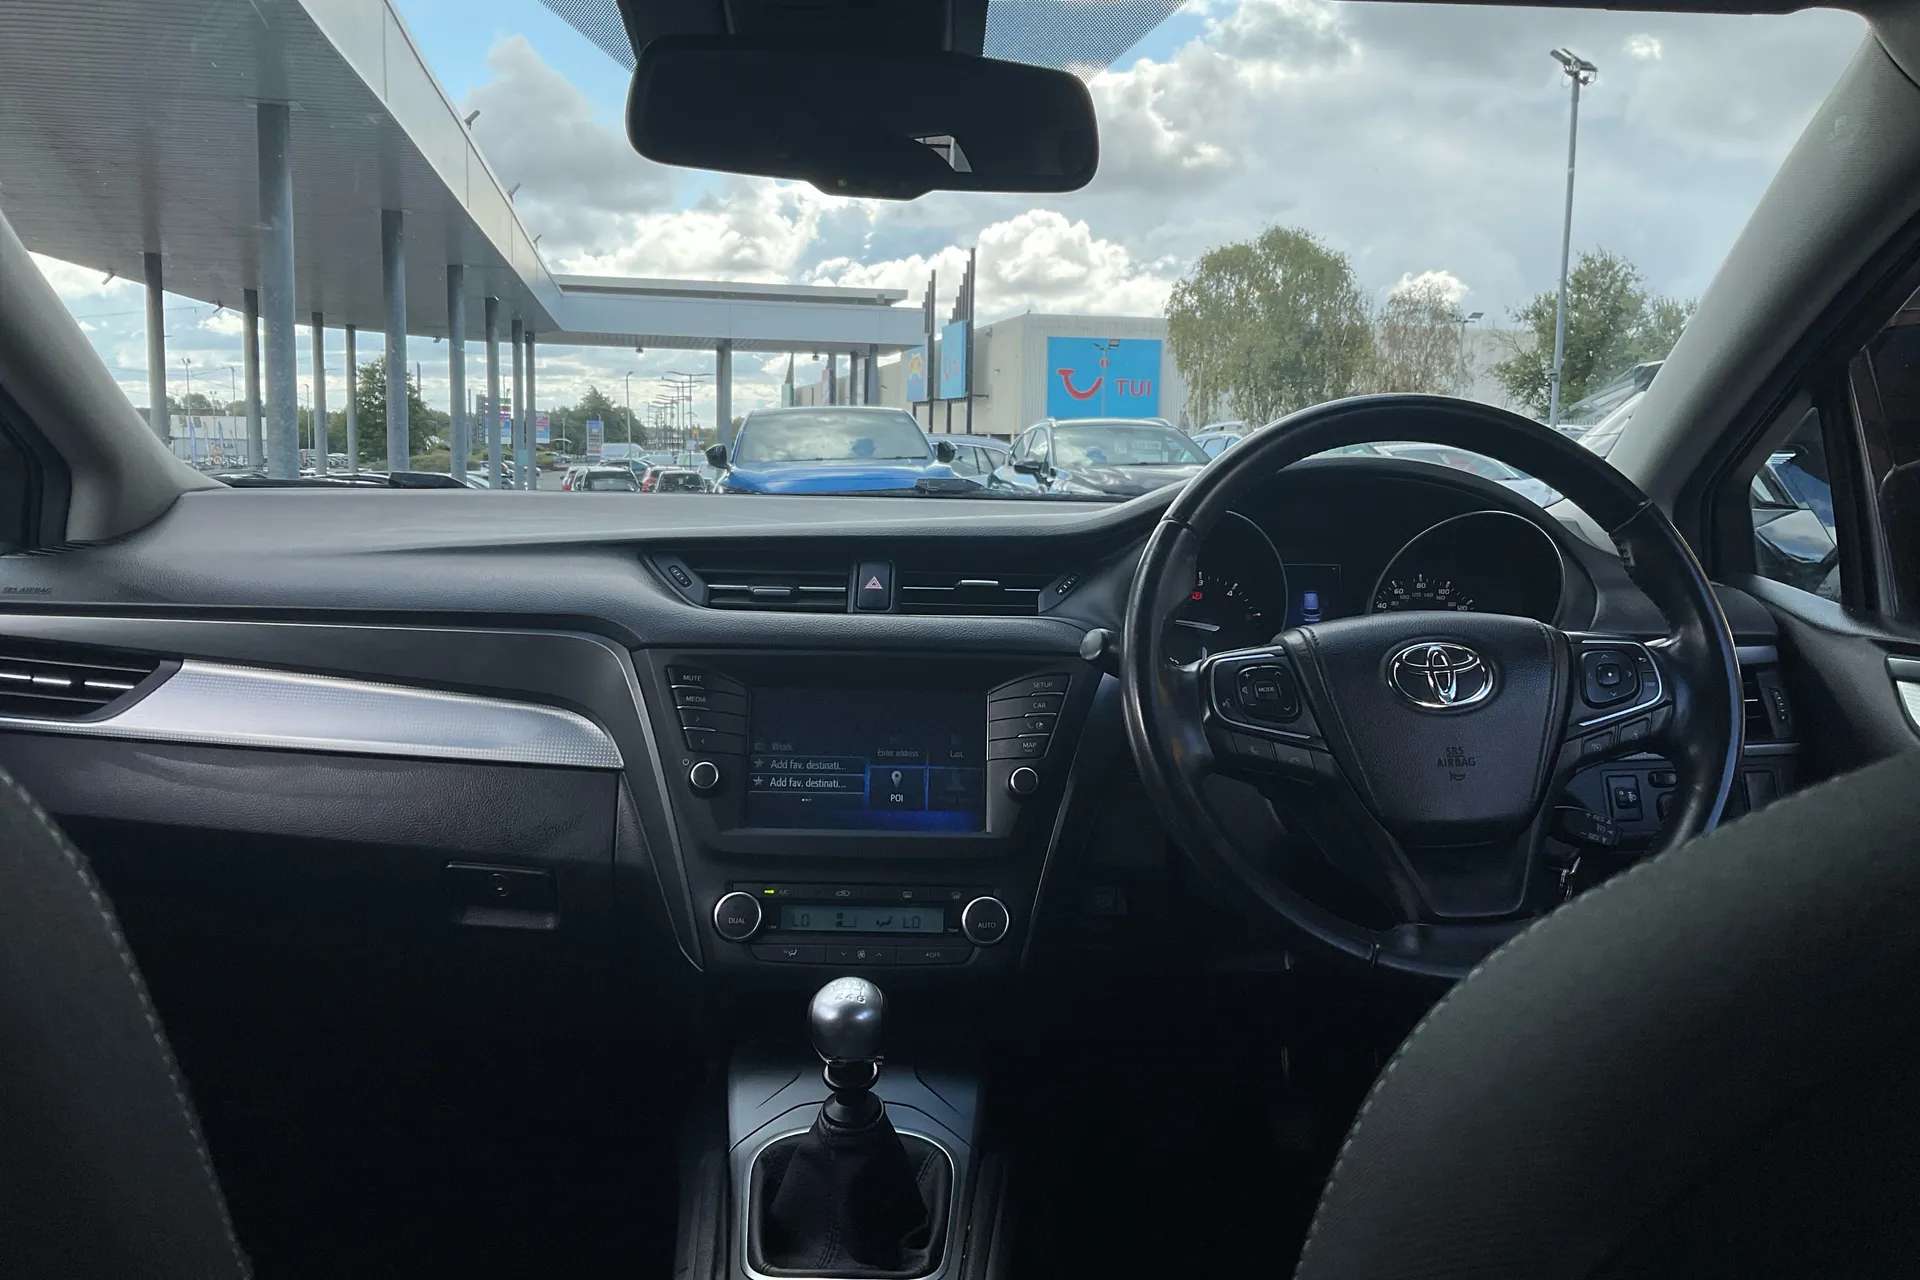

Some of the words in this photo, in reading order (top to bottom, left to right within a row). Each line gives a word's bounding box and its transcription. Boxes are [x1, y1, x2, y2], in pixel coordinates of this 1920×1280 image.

[1115, 379, 1152, 396] TUI
[682, 674, 702, 682] MUTE
[685, 695, 706, 703] MEDIA
[1446, 746, 1465, 756] SRS
[770, 759, 788, 769] Add
[789, 759, 804, 770] fav.
[1437, 757, 1476, 768] AIRBAG
[769, 777, 787, 788] Add
[789, 777, 804, 788] fav.
[805, 777, 847, 788] destinati...
[890, 793, 904, 803] POI
[977, 921, 997, 929] AUTO
